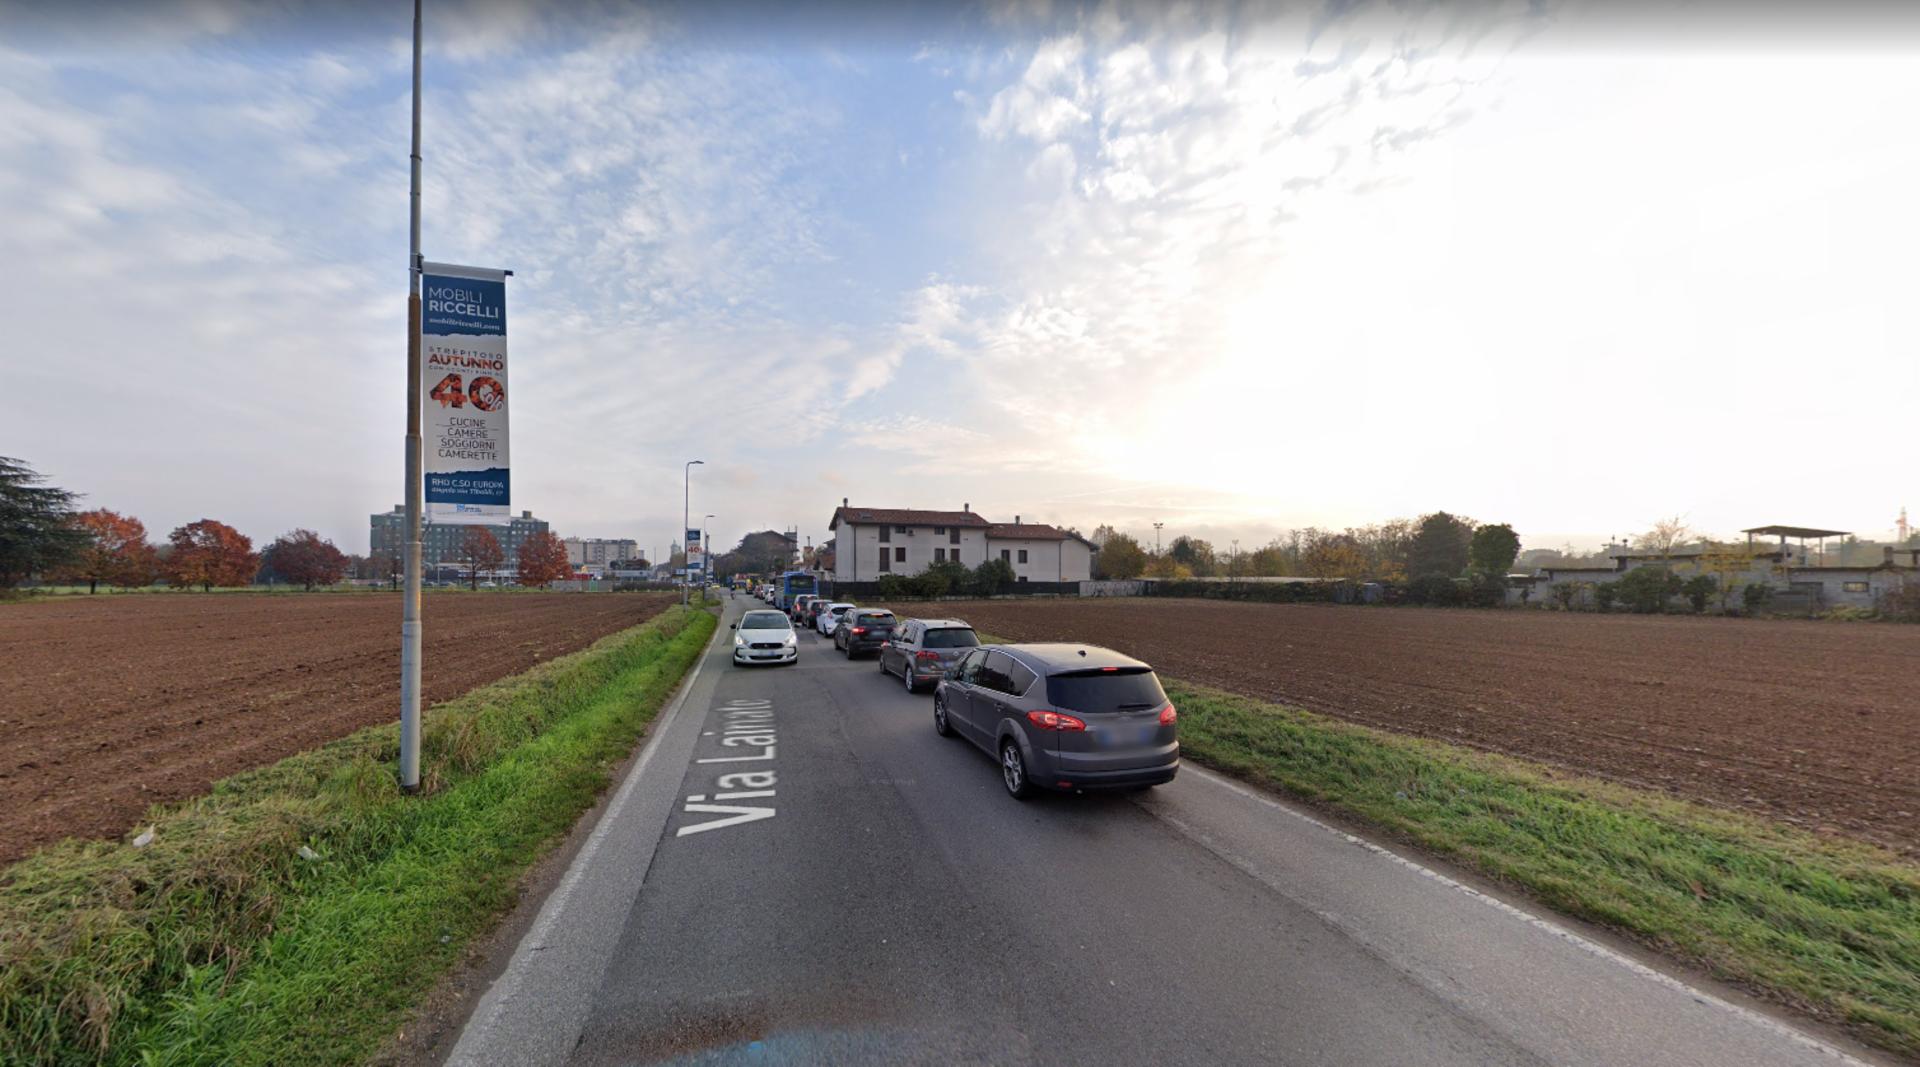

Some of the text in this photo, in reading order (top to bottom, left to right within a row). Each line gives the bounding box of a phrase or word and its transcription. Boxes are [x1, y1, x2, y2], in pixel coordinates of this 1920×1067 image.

[428, 287, 482, 304] MOBILI
[428, 300, 499, 319] RICCELLI
[428, 346, 503, 360] STREPITOSO
[428, 353, 504, 371] AUTUNNO
[449, 417, 487, 429] CUCINE
[447, 428, 489, 439] CAMERE
[440, 438, 496, 451] SOGGIORNI
[438, 449, 498, 461] CAMERETTE
[432, 478, 450, 487] RHO
[473, 481, 504, 490] EUROPA
